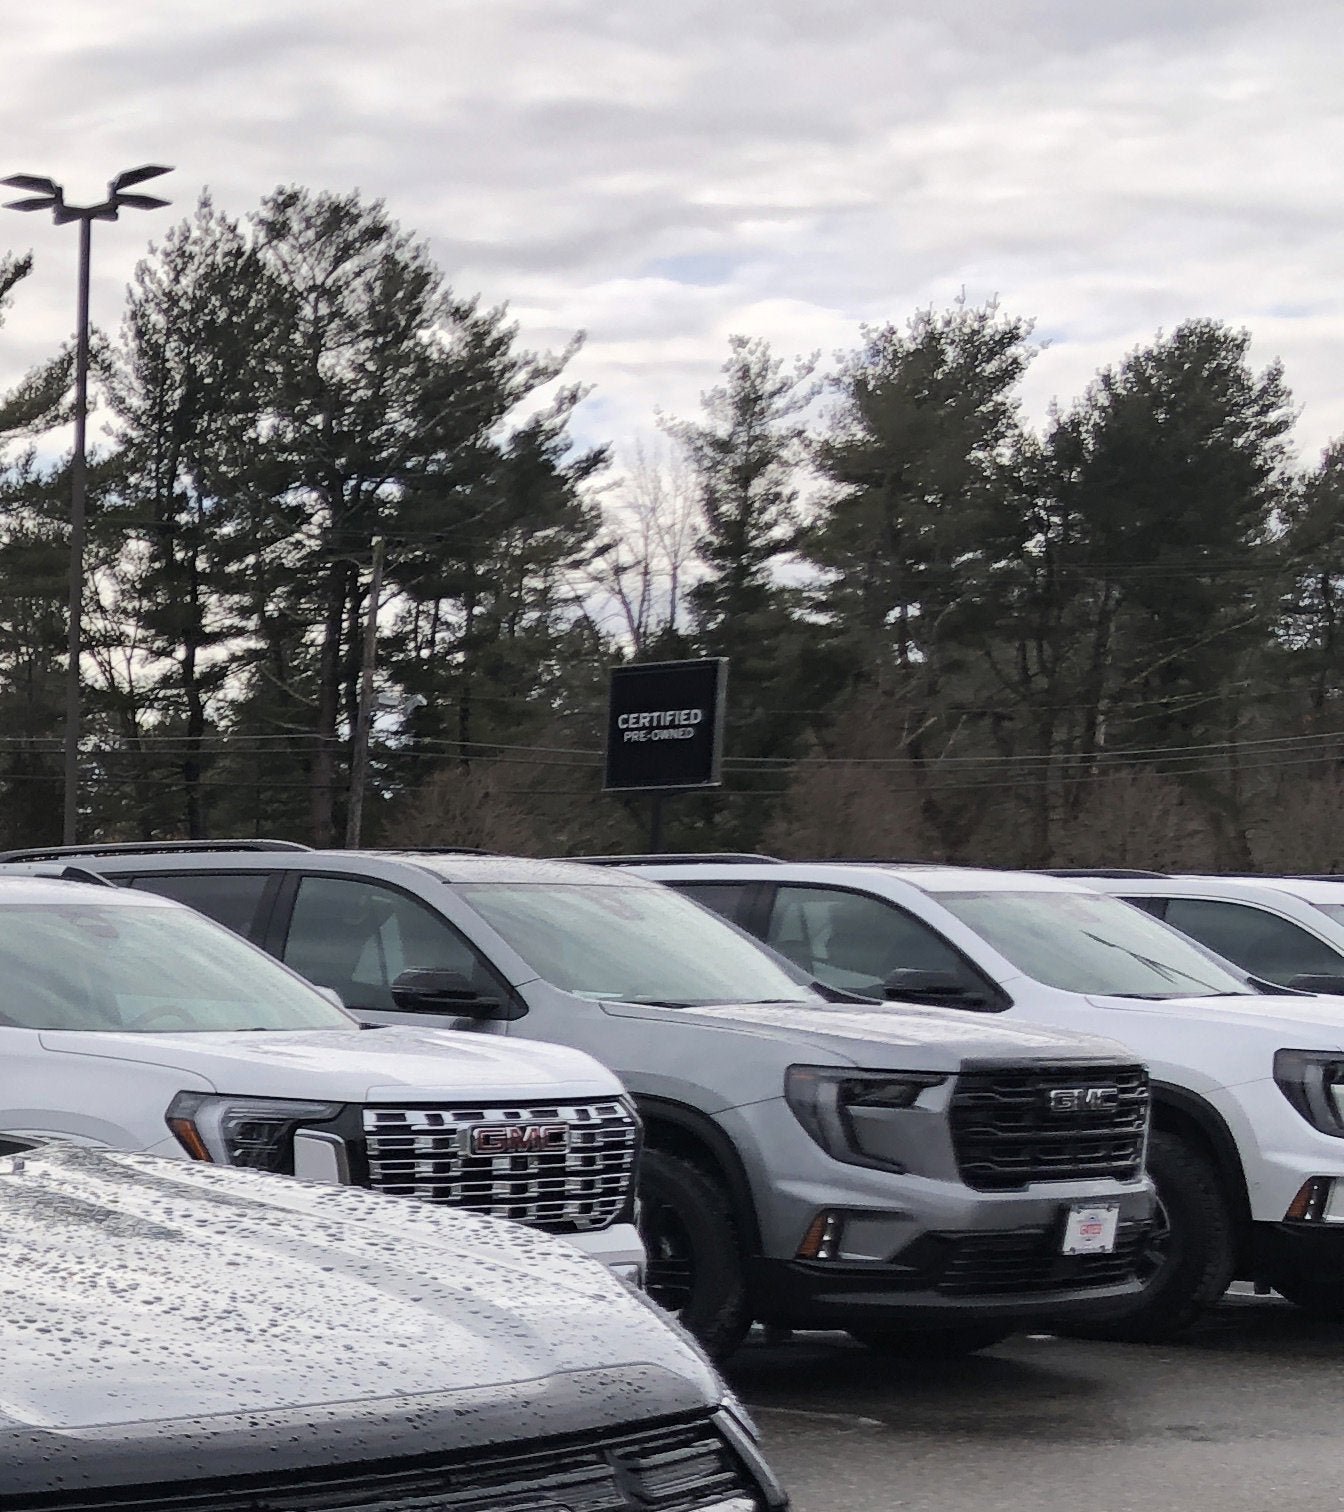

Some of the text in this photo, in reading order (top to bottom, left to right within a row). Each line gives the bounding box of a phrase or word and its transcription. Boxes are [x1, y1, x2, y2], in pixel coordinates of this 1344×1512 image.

[618, 709, 702, 729] CERTIFIED
[624, 728, 694, 742] PRE-OWNED
[1050, 1088, 1118, 1113] GMC
[472, 1125, 568, 1154] GMC
